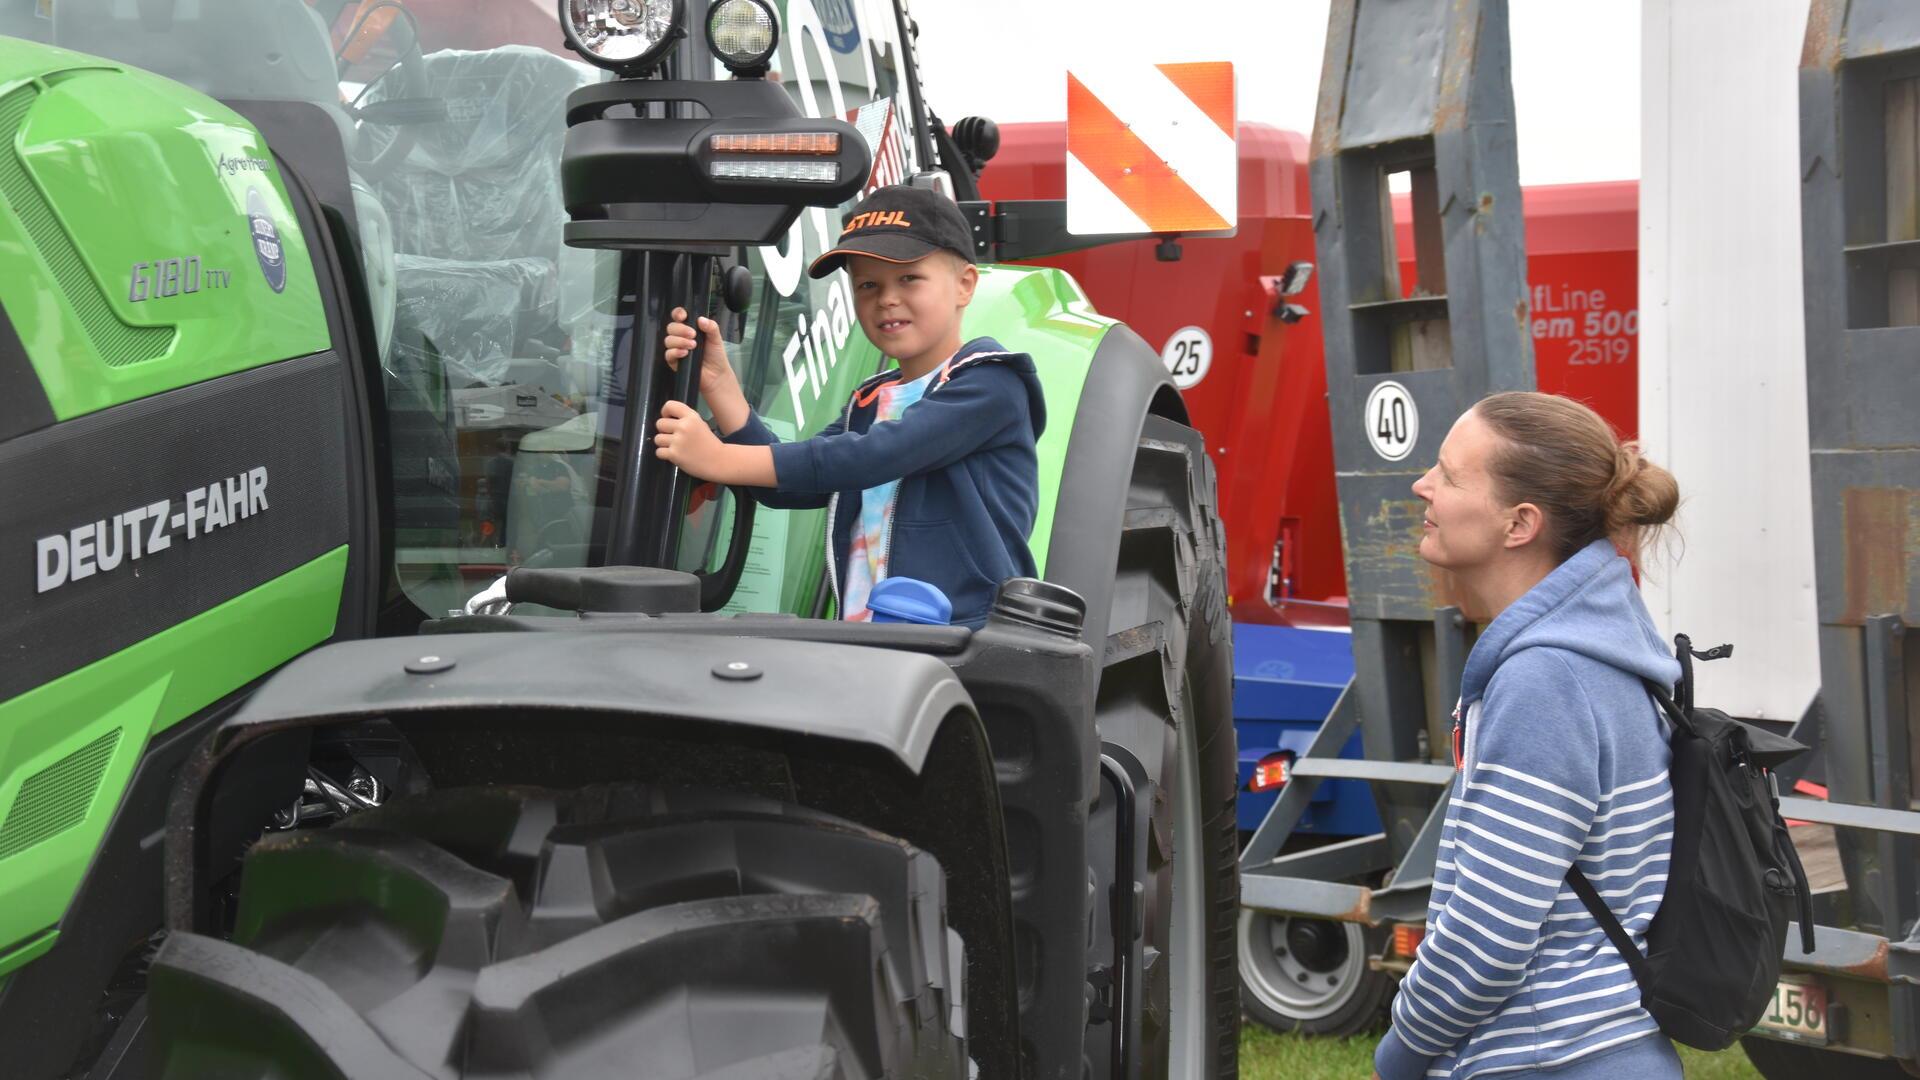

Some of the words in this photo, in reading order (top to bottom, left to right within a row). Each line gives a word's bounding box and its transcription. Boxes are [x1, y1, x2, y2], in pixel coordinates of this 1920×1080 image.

[841, 210, 912, 236] STIHL
[128, 256, 201, 303] 6180
[205, 269, 231, 289] TTV
[1532, 316, 1575, 339] em
[1172, 340, 1202, 376] 25
[1567, 337, 1629, 365] 2519
[1378, 396, 1407, 445] 40
[36, 465, 269, 594] DEUTZ-FAHR
